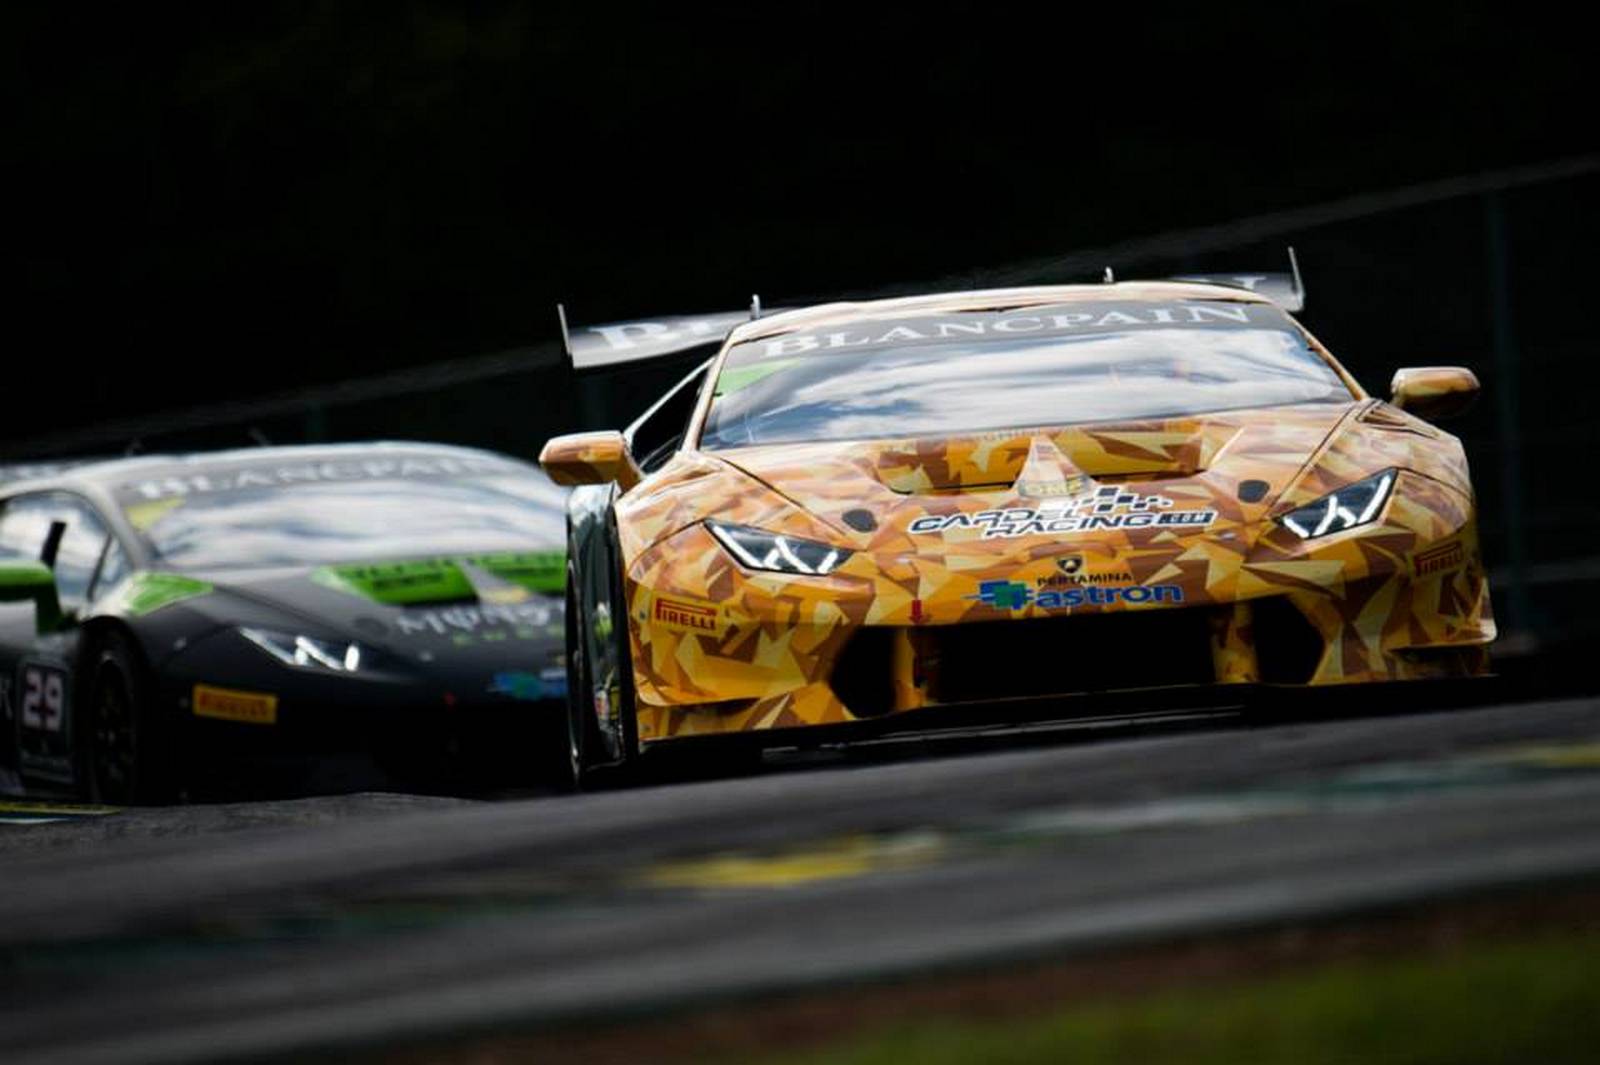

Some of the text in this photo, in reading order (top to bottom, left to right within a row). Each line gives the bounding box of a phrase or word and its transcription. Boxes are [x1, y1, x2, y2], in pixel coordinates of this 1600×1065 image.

[763, 303, 1252, 357] BLANCPAIN
[986, 511, 1155, 538] RACING
[1037, 572, 1132, 587] PERTAMINA
[1036, 584, 1183, 608] astron
[656, 598, 717, 630] PIRELLI
[24, 667, 62, 732] 29
